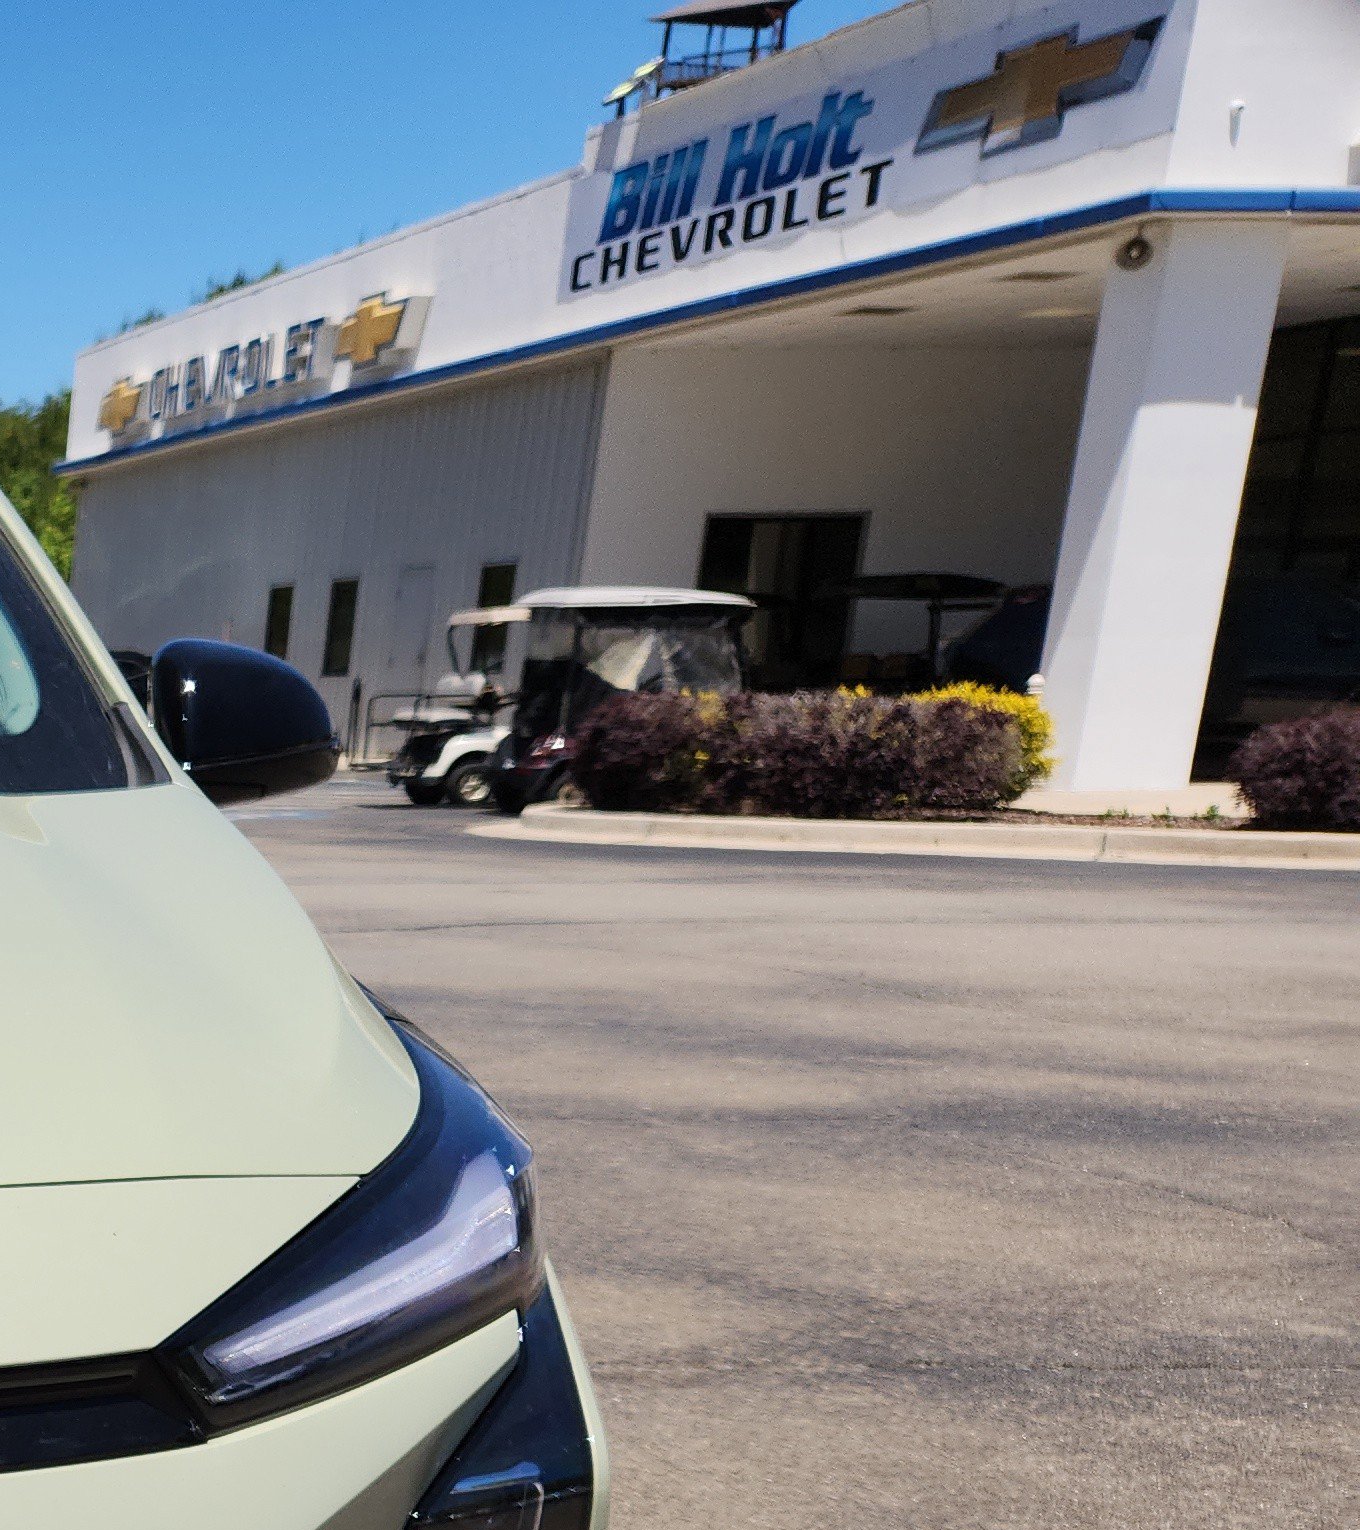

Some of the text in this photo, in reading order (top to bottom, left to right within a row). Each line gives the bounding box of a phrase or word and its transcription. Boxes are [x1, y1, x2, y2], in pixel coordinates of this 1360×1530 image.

[570, 159, 894, 293] CHEVROLET
[598, 88, 874, 245] Bill Holt
[148, 316, 326, 421] CHEVROLET
